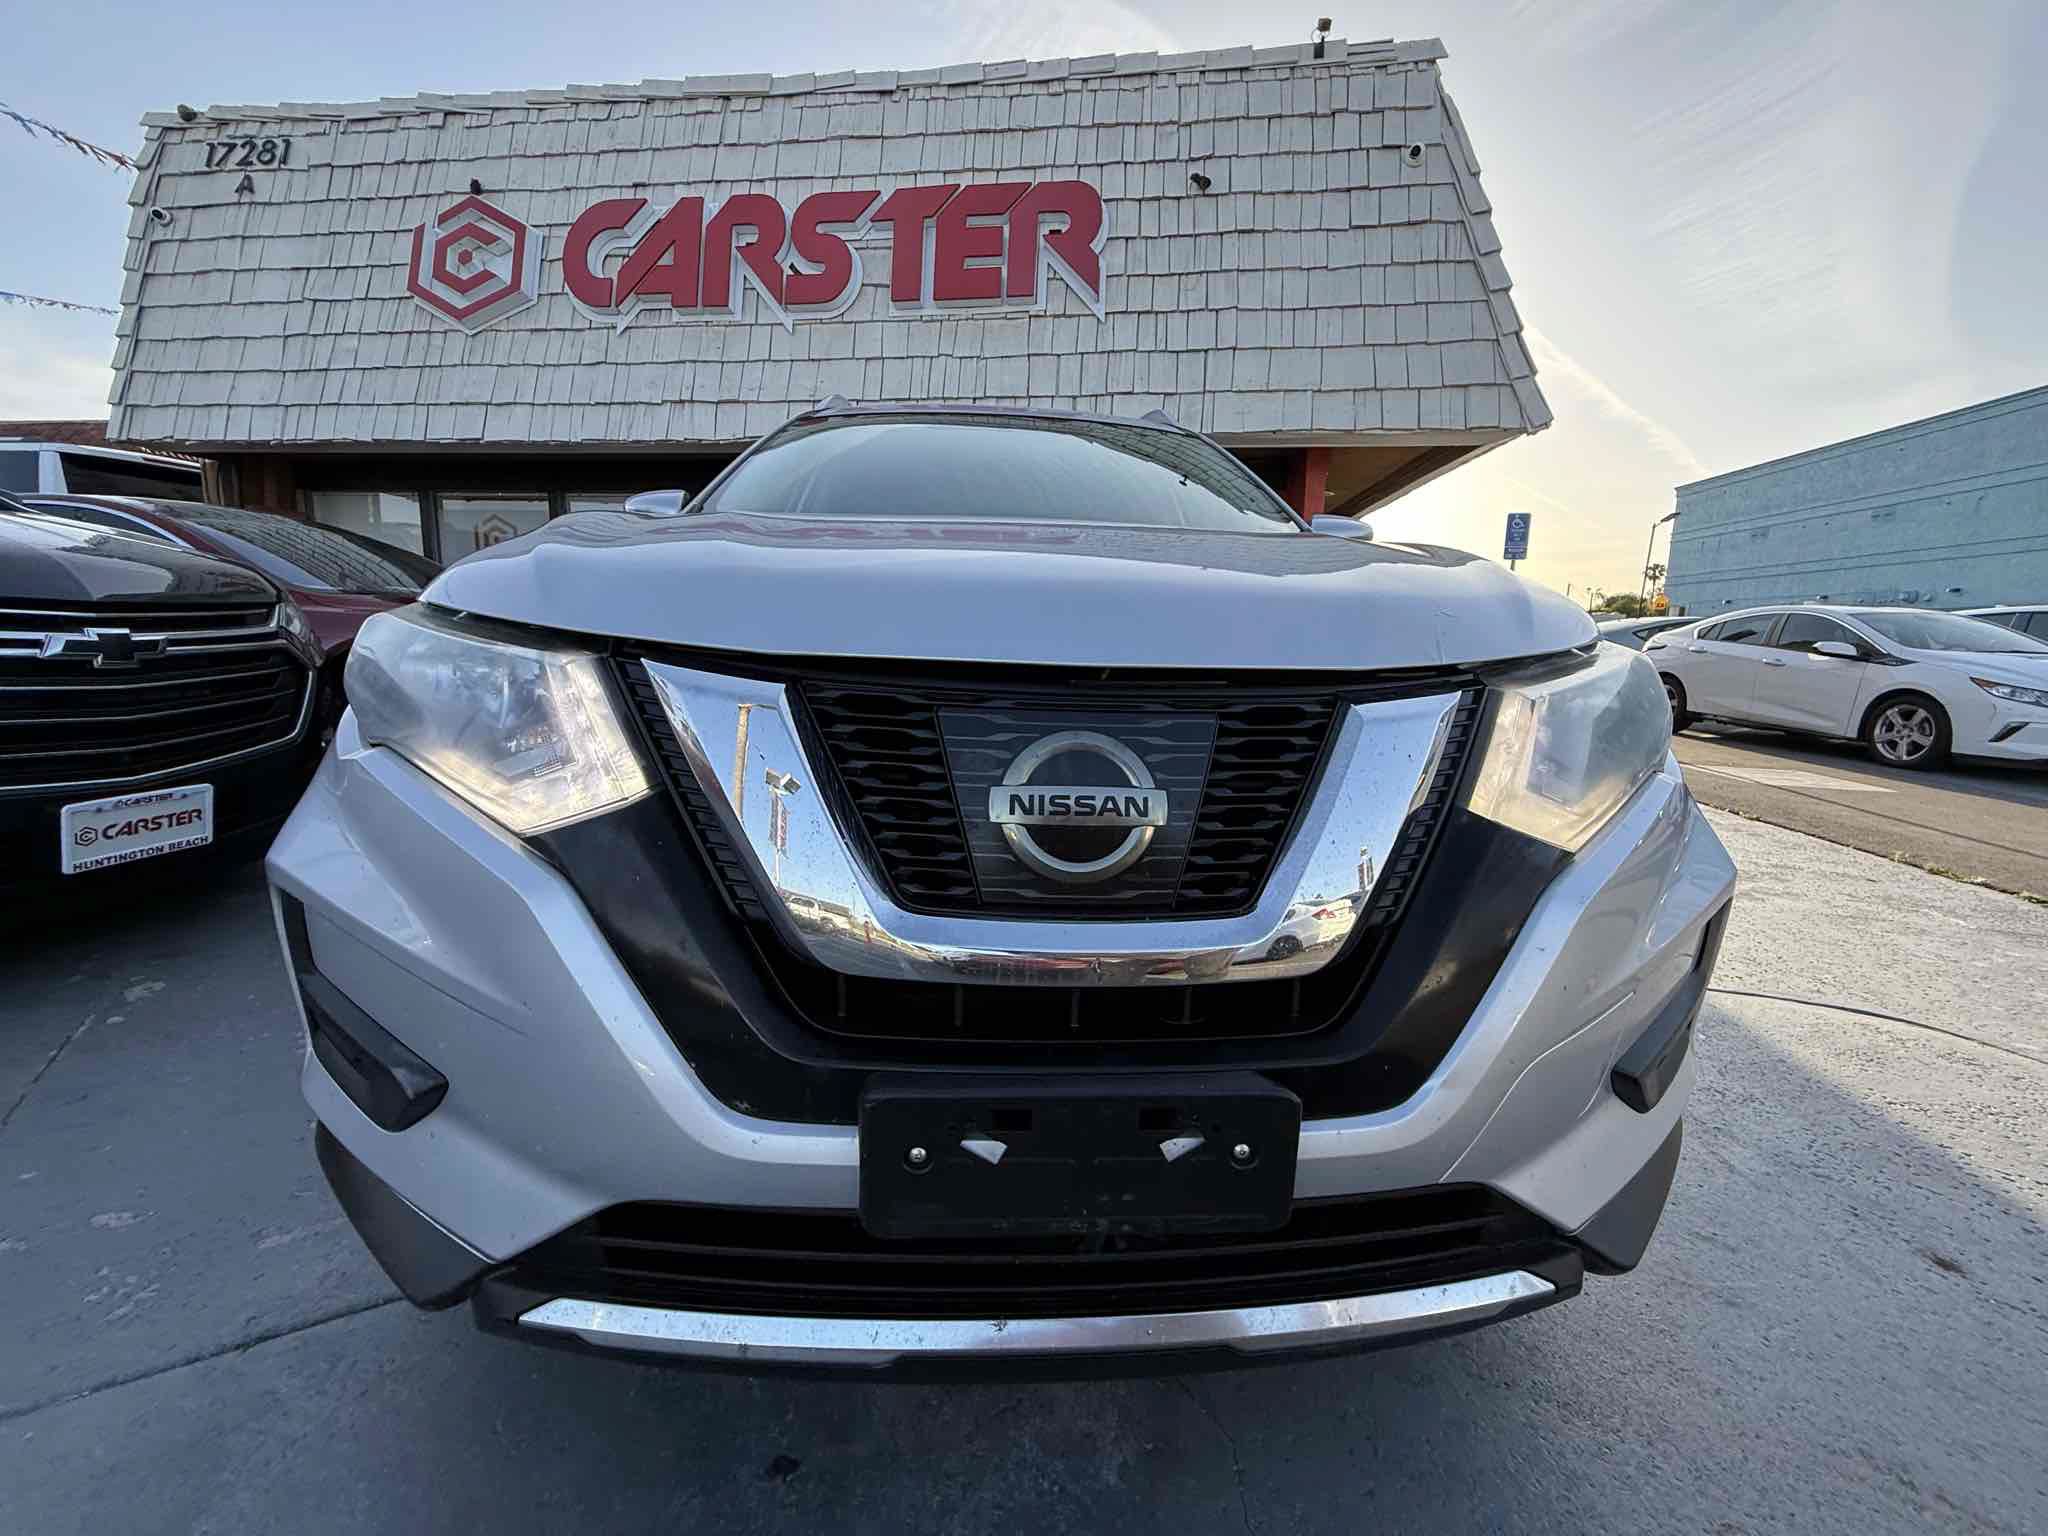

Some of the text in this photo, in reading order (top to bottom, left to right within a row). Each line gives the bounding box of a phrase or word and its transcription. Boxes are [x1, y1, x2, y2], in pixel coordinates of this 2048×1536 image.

[206, 139, 291, 168] 17281
[235, 174, 255, 195] A
[562, 180, 1103, 310] CARSTER
[1008, 794, 1149, 818] NISSAN
[102, 808, 203, 839] CARSTER
[72, 835, 209, 872] HUNTINGTON BEACH
